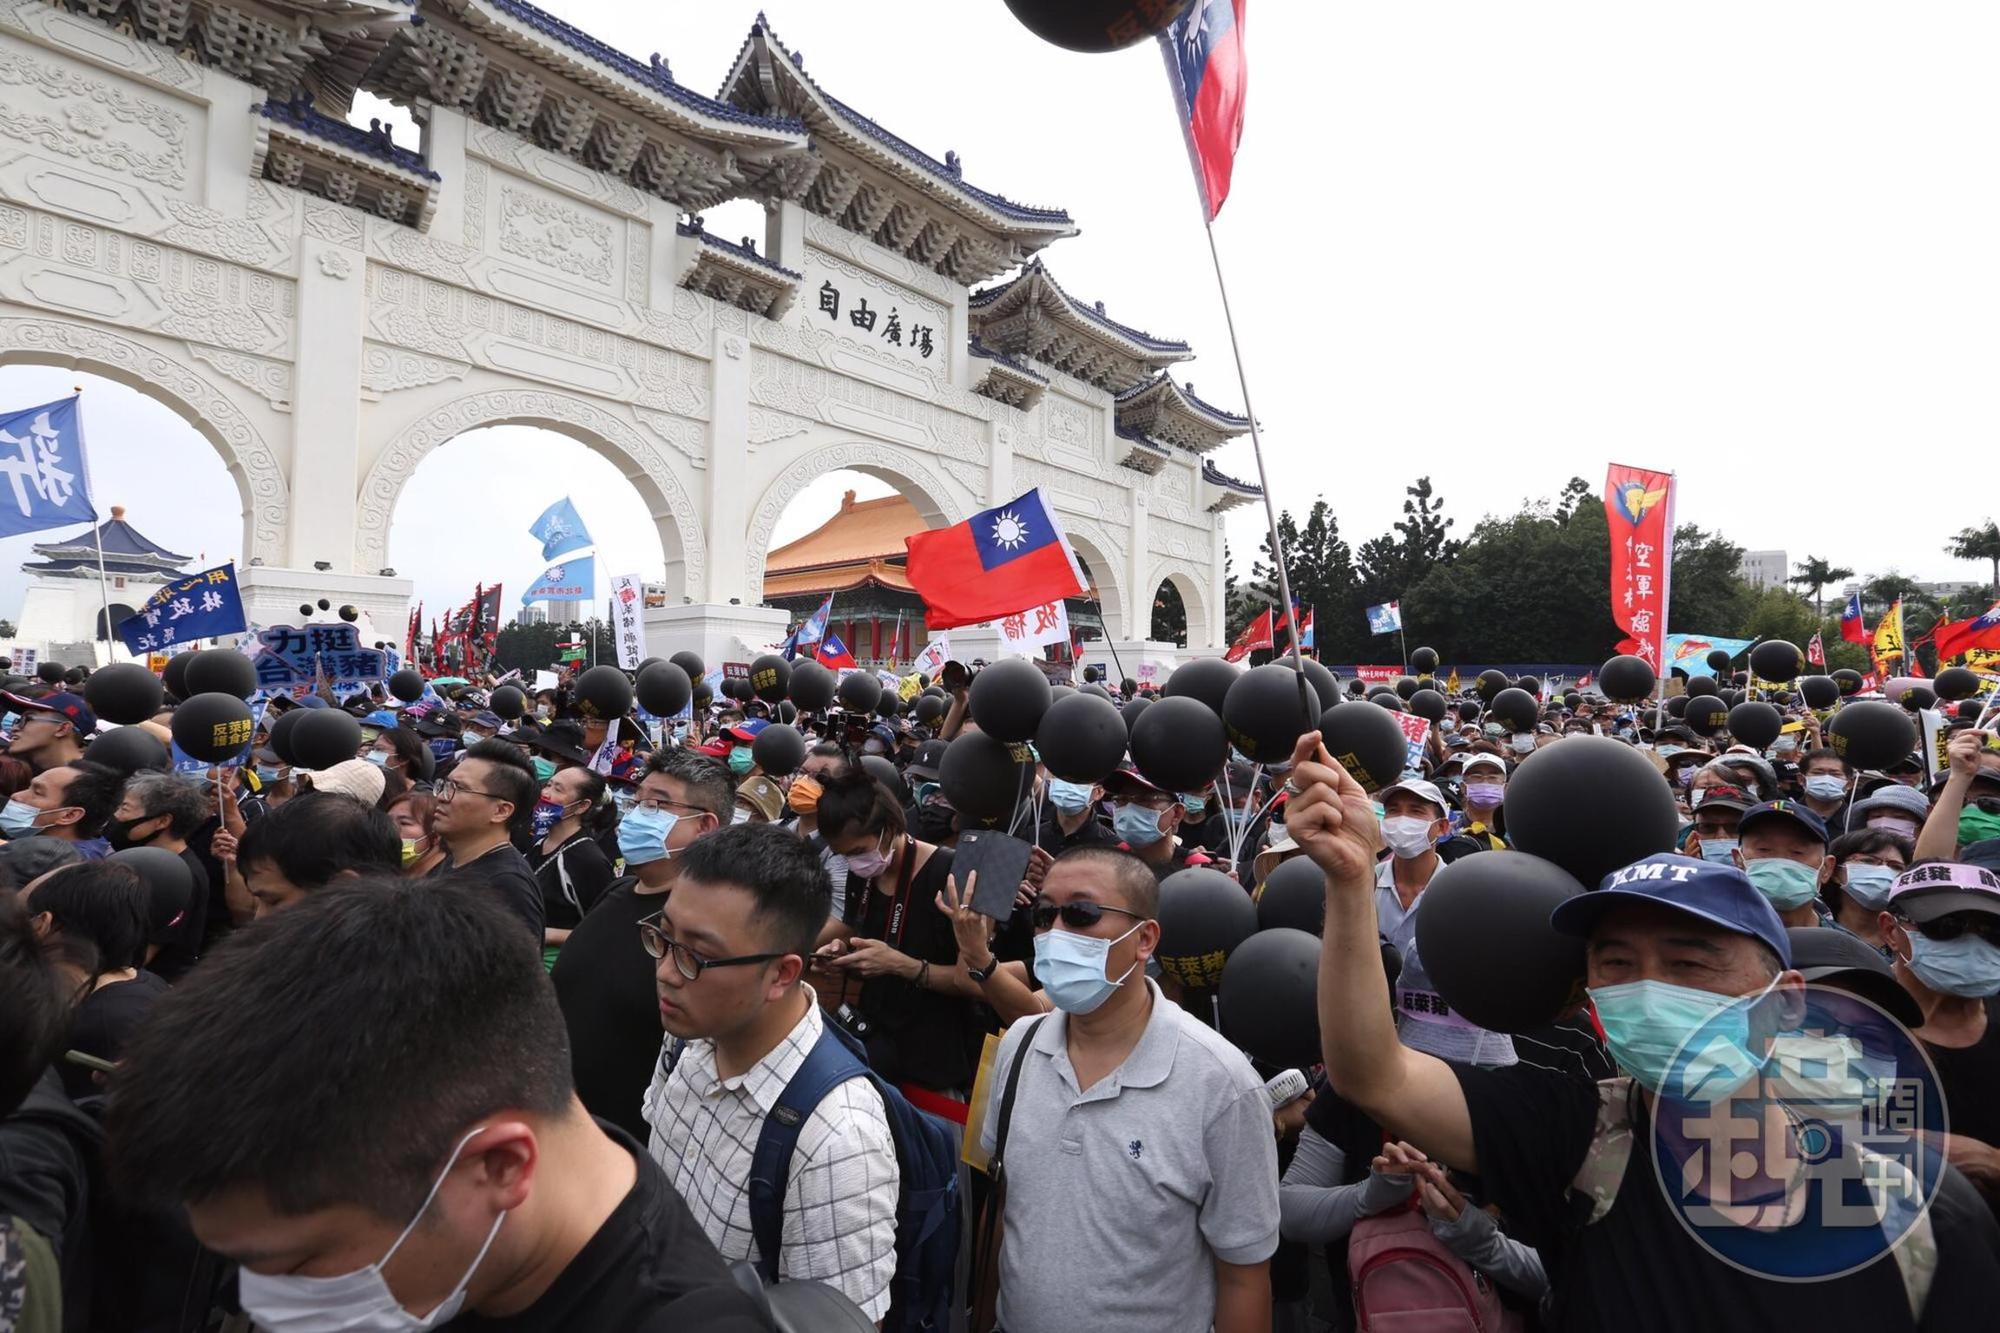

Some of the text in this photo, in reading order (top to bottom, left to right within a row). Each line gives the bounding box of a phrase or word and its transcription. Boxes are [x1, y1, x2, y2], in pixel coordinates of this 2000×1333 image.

[818, 280, 934, 359] 自由廣場
[268, 629, 353, 654] 力挺
[256, 651, 380, 684] 台灣豬
[213, 719, 251, 736] 反萊豬
[1609, 863, 1698, 891] KMT
[1898, 866, 1952, 888] 反萊豬
[891, 903, 903, 934] Canon
[1159, 950, 1226, 975] 反萊豬
[1403, 991, 1450, 1017] 反萊豬
